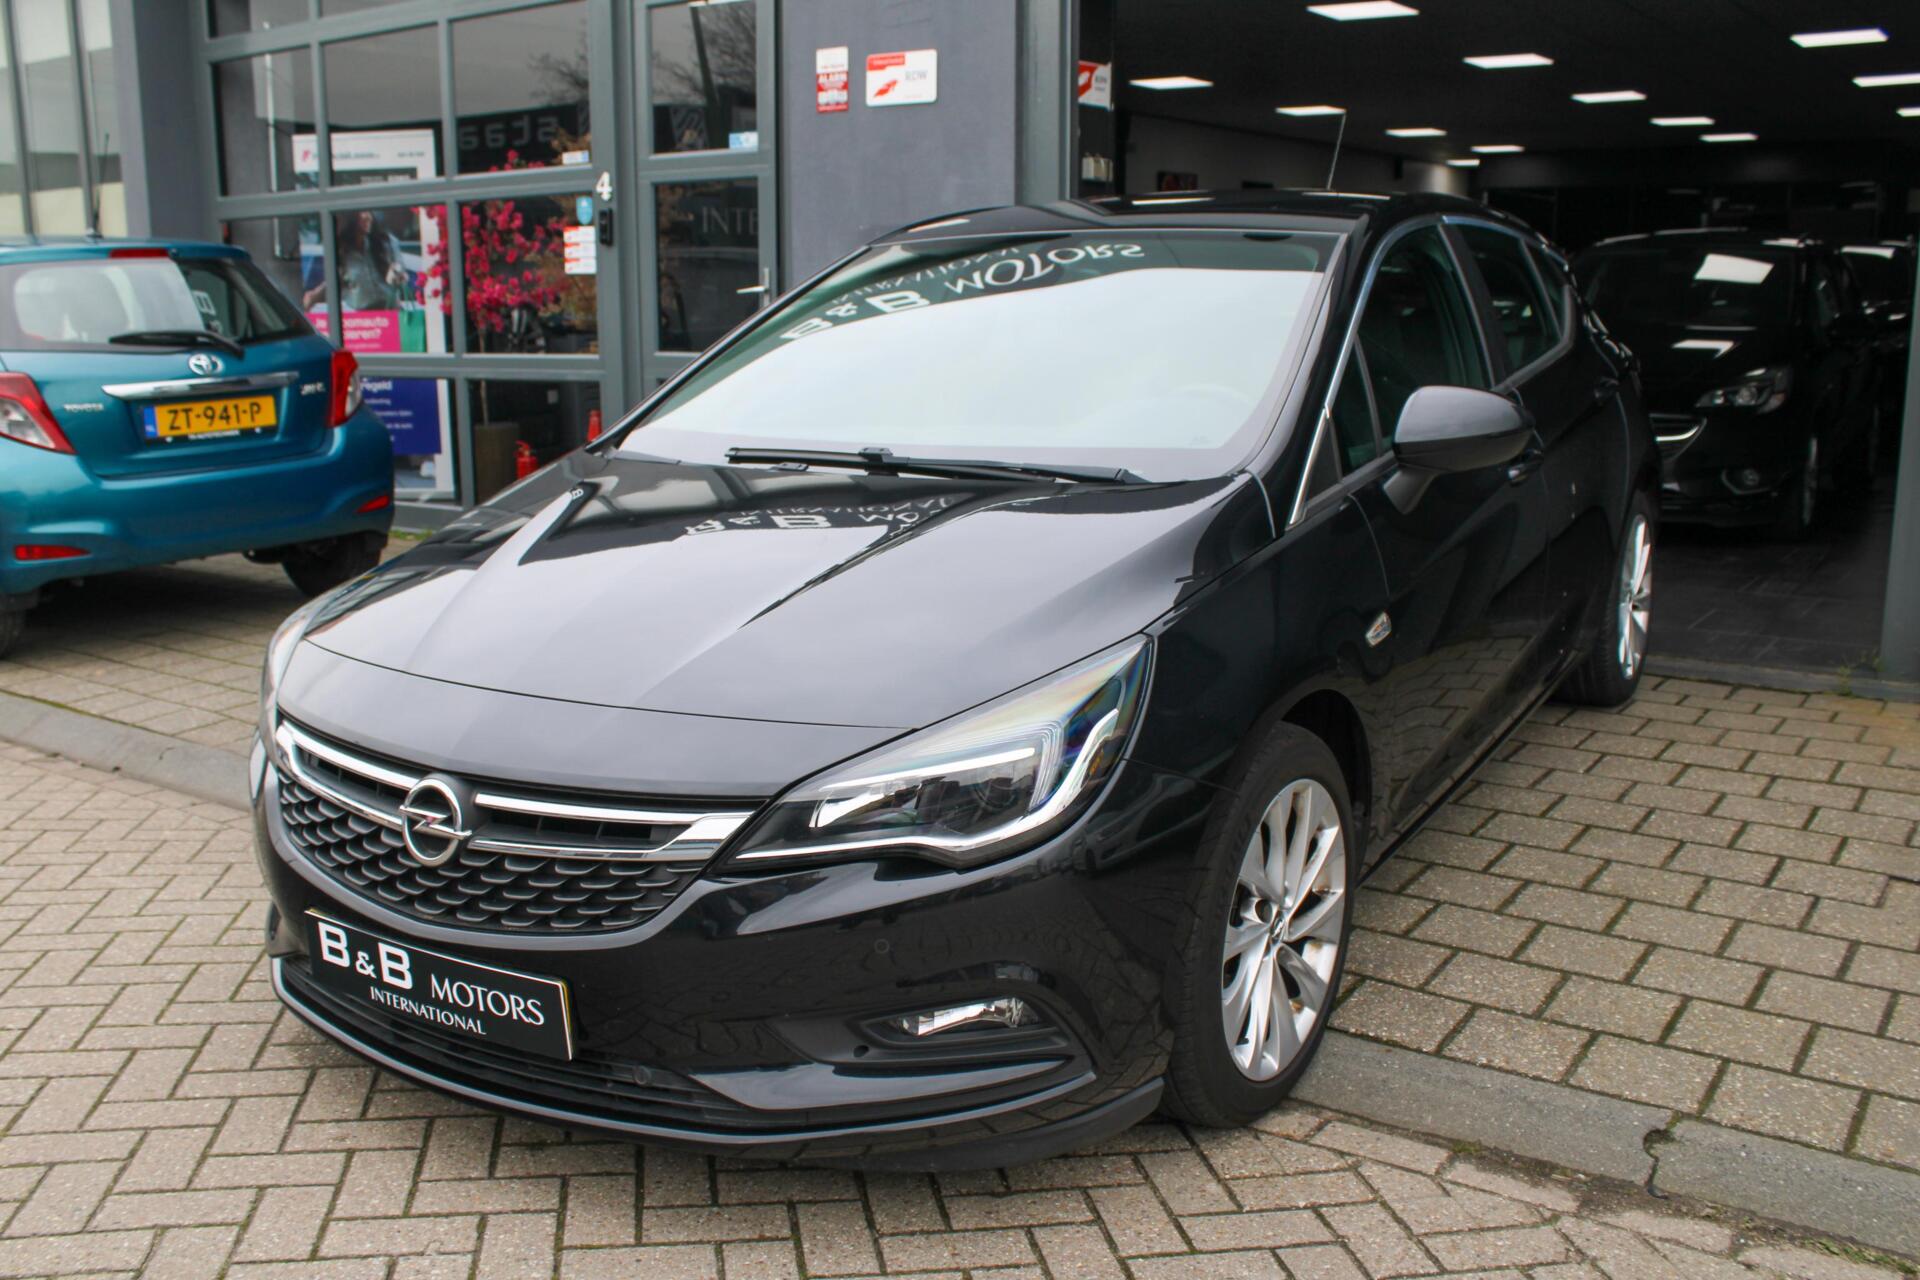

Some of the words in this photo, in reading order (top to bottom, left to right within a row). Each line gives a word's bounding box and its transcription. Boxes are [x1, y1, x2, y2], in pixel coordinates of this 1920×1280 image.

[596, 171, 613, 201] 4
[168, 401, 262, 431] ZT-941-P
[370, 985, 487, 1036] INTERNATIONAL
[431, 973, 545, 1026] MOTORS
